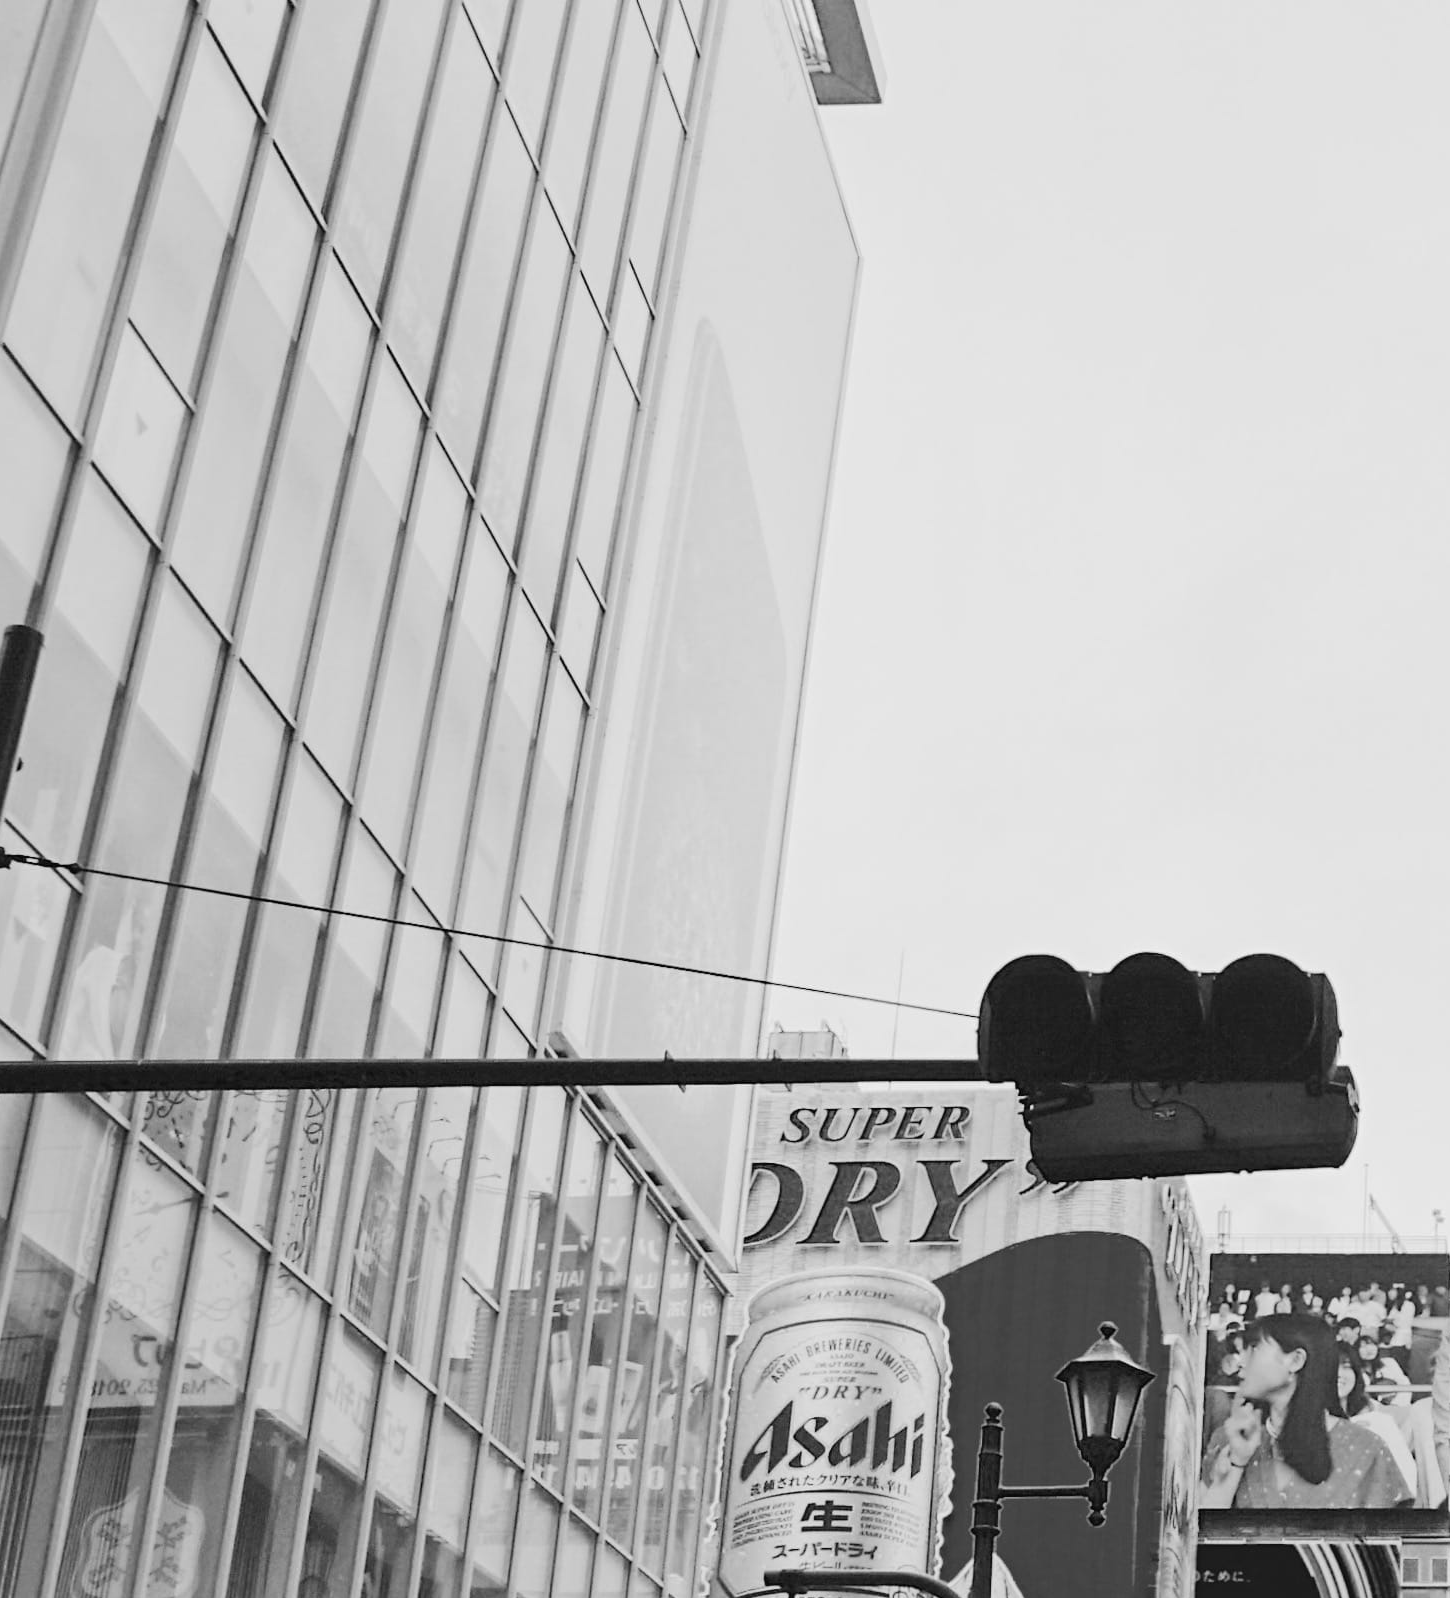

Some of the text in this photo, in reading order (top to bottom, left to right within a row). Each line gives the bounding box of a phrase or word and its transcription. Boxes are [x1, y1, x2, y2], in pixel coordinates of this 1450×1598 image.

[779, 1105, 971, 1144] SUPER
[770, 1337, 911, 1384] ASAHI BREWERIES LIMITED
[739, 1399, 926, 1483] Asahi
[800, 1500, 854, 1532] 生
[771, 1540, 879, 1560] スーパードライ
